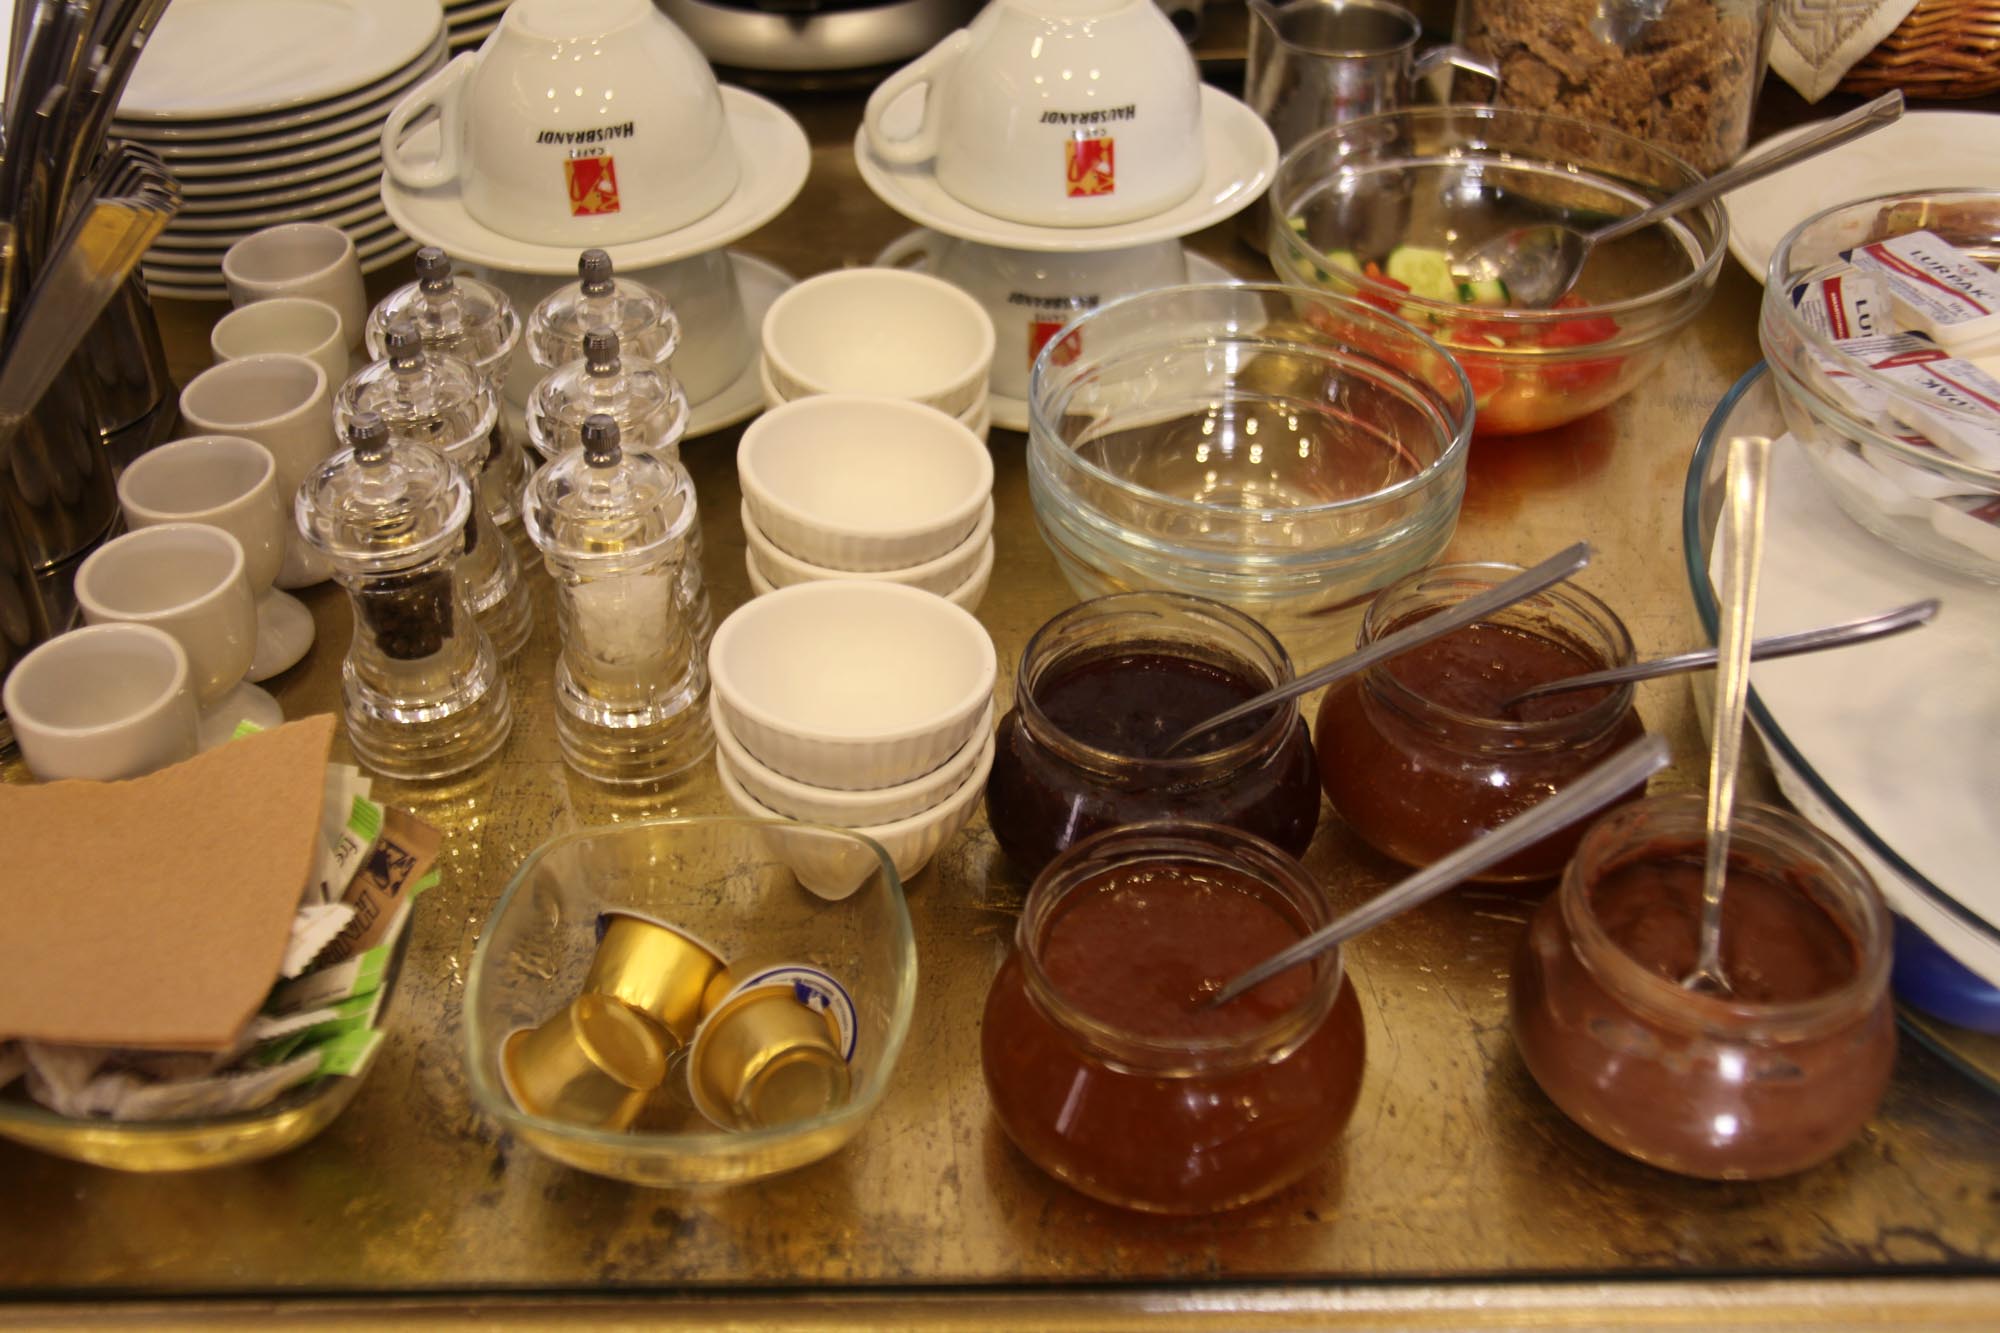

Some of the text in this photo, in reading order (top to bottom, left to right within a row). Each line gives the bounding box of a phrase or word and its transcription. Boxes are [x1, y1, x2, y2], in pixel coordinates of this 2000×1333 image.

[1039, 104, 1136, 124] HAUSBRANDT
[536, 121, 634, 144] HAUSBRANDT
[1910, 250, 1989, 298] LURPAK
